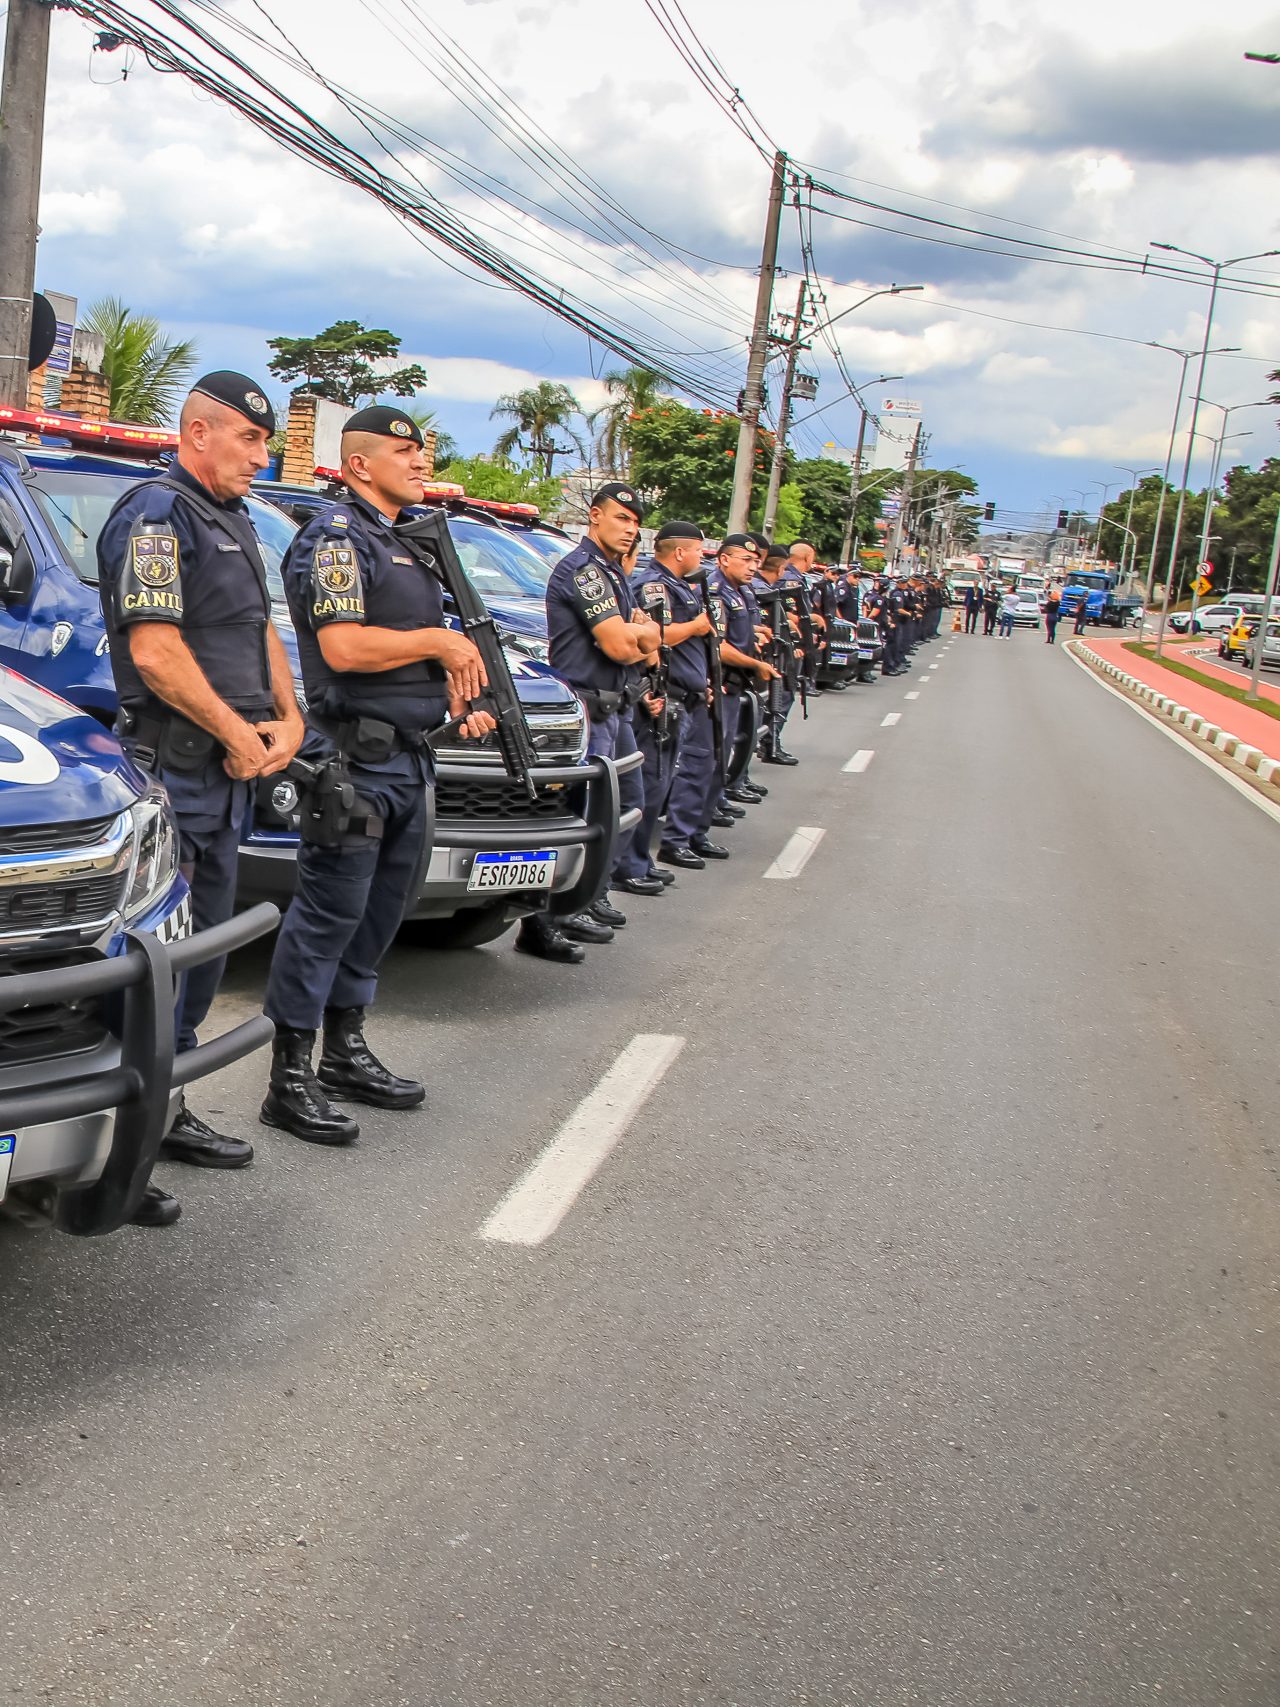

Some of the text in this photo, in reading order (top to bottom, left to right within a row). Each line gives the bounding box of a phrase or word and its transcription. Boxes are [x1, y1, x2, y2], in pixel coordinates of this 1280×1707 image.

[124, 591, 183, 613] CANIL
[313, 597, 365, 616] CANIL
[584, 596, 618, 619] ROMU
[477, 864, 546, 886] ESR9D86
